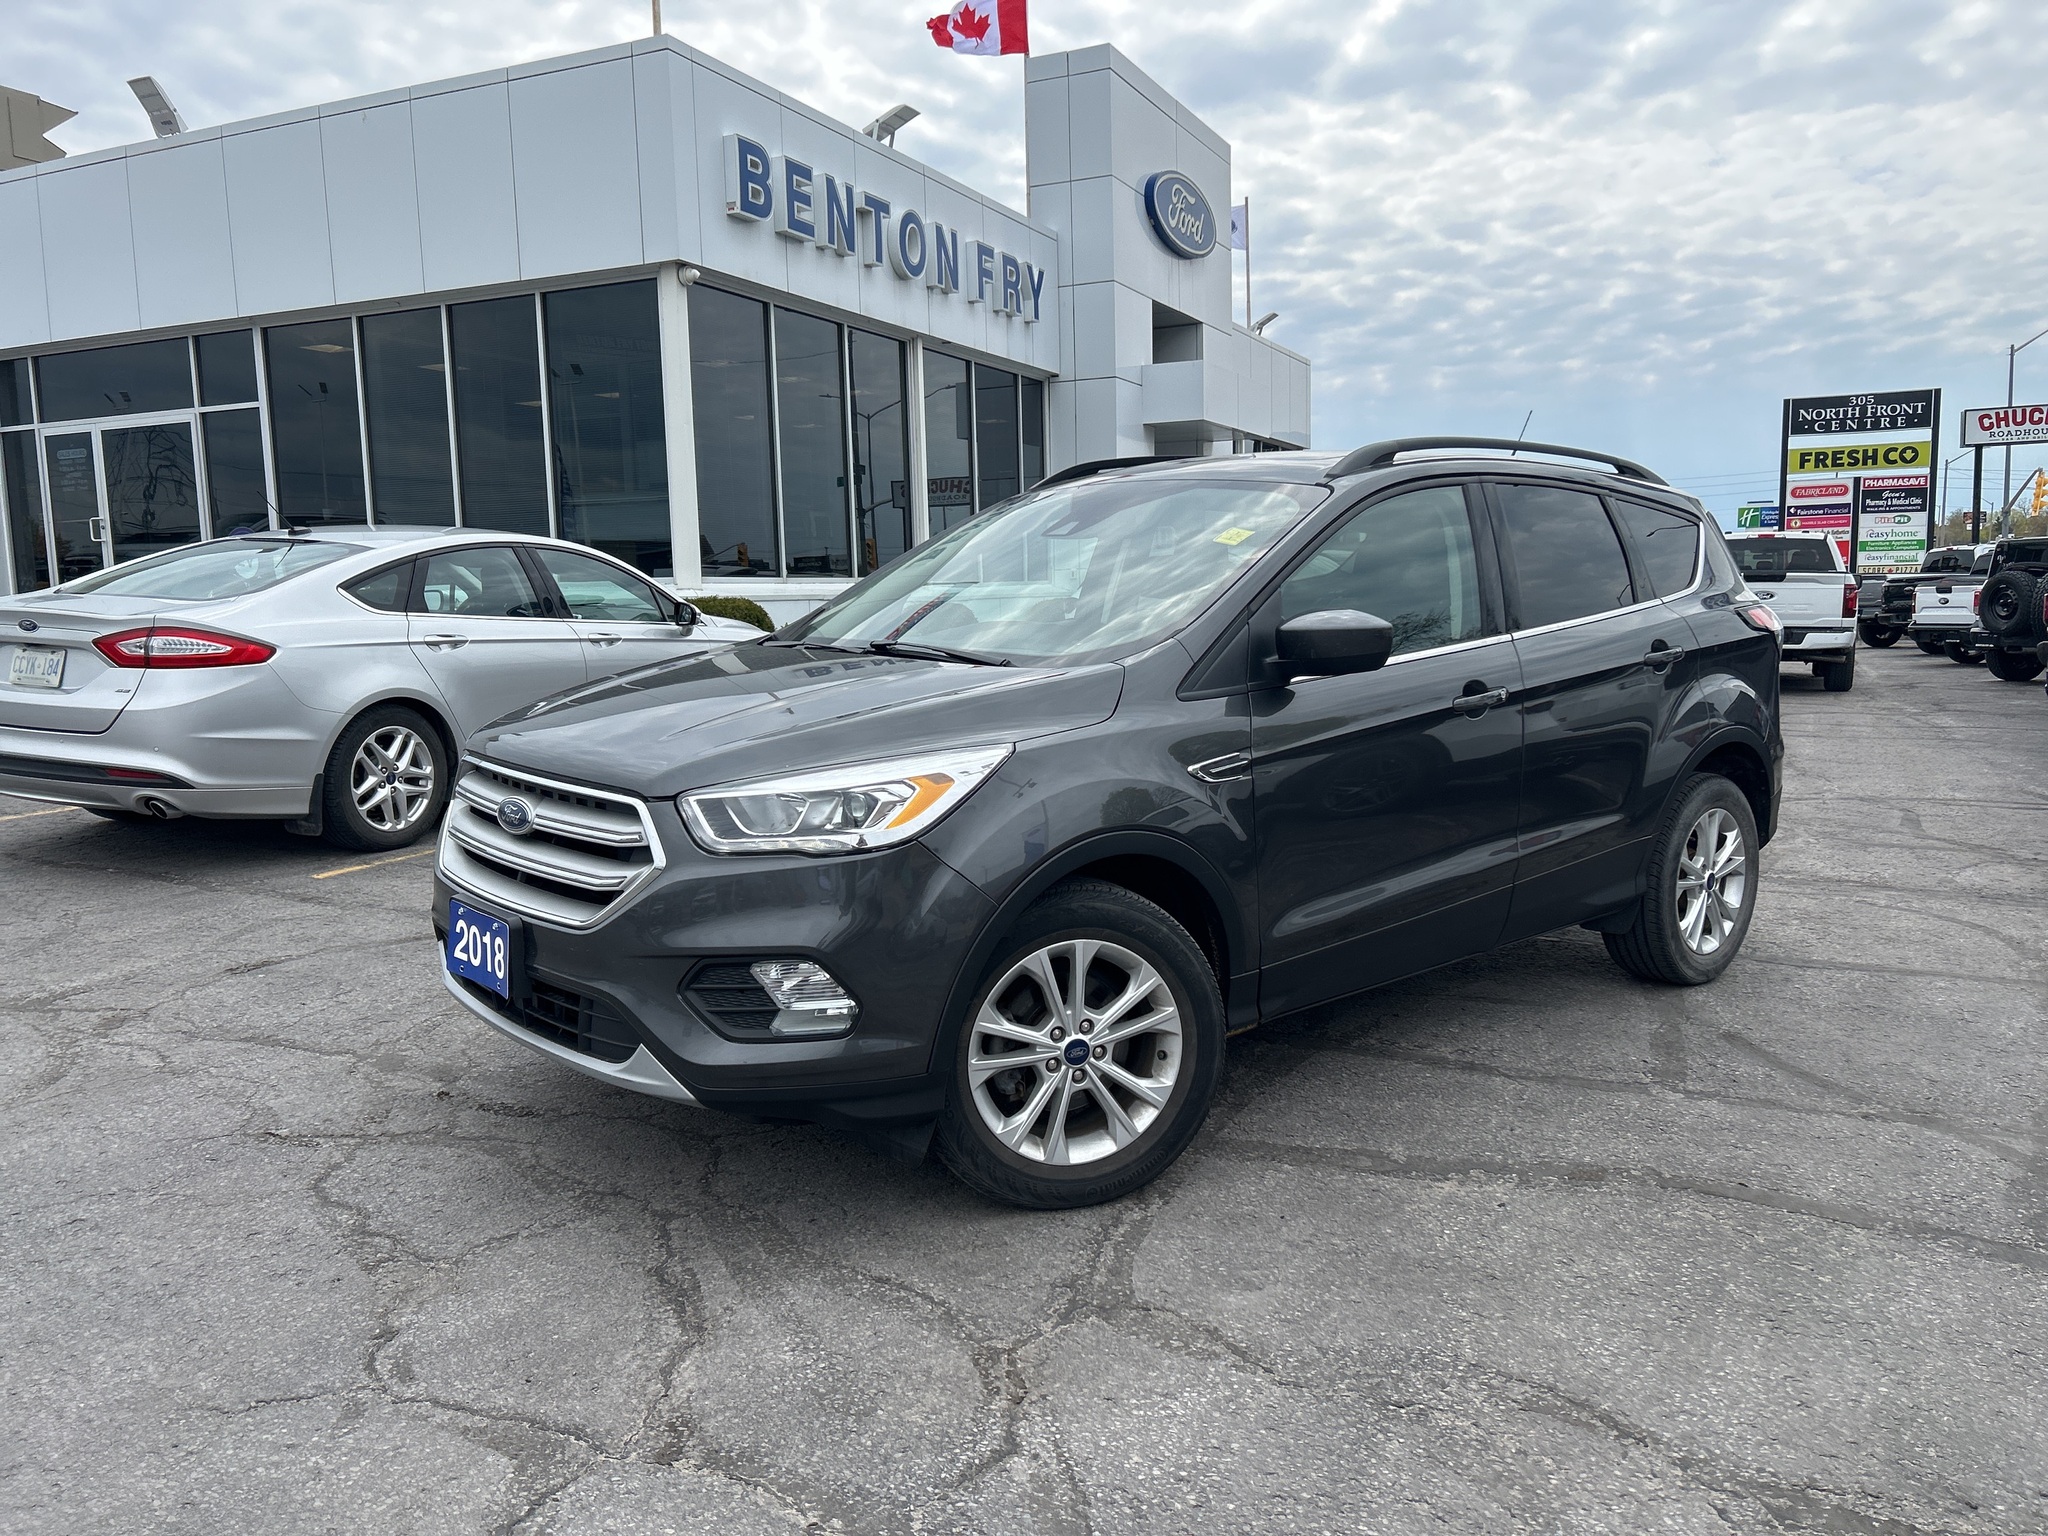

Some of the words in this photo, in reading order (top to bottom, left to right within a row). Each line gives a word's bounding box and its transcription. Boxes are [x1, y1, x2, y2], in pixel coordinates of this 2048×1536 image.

[1168, 183, 1205, 244] Ford
[728, 133, 959, 295] BENTON
[968, 240, 1045, 323] FRY
[1848, 395, 1875, 406] 305
[1798, 406, 1860, 421] NORTH
[1866, 402, 1926, 417] FRONT
[1978, 407, 2048, 432] CHUC
[1814, 416, 1906, 432] CENTRE
[1864, 477, 1926, 487] PHARMASAVE
[1795, 486, 1845, 496] FABRICLAND
[1865, 498, 1887, 507] Pharmacy
[1892, 497, 1909, 505] Medical
[1910, 497, 1923, 505] Clinic
[1868, 529, 1919, 540] easyhome
[1866, 552, 1919, 562] easyfinancial
[500, 803, 522, 825] Ford
[453, 919, 505, 980] 2018
